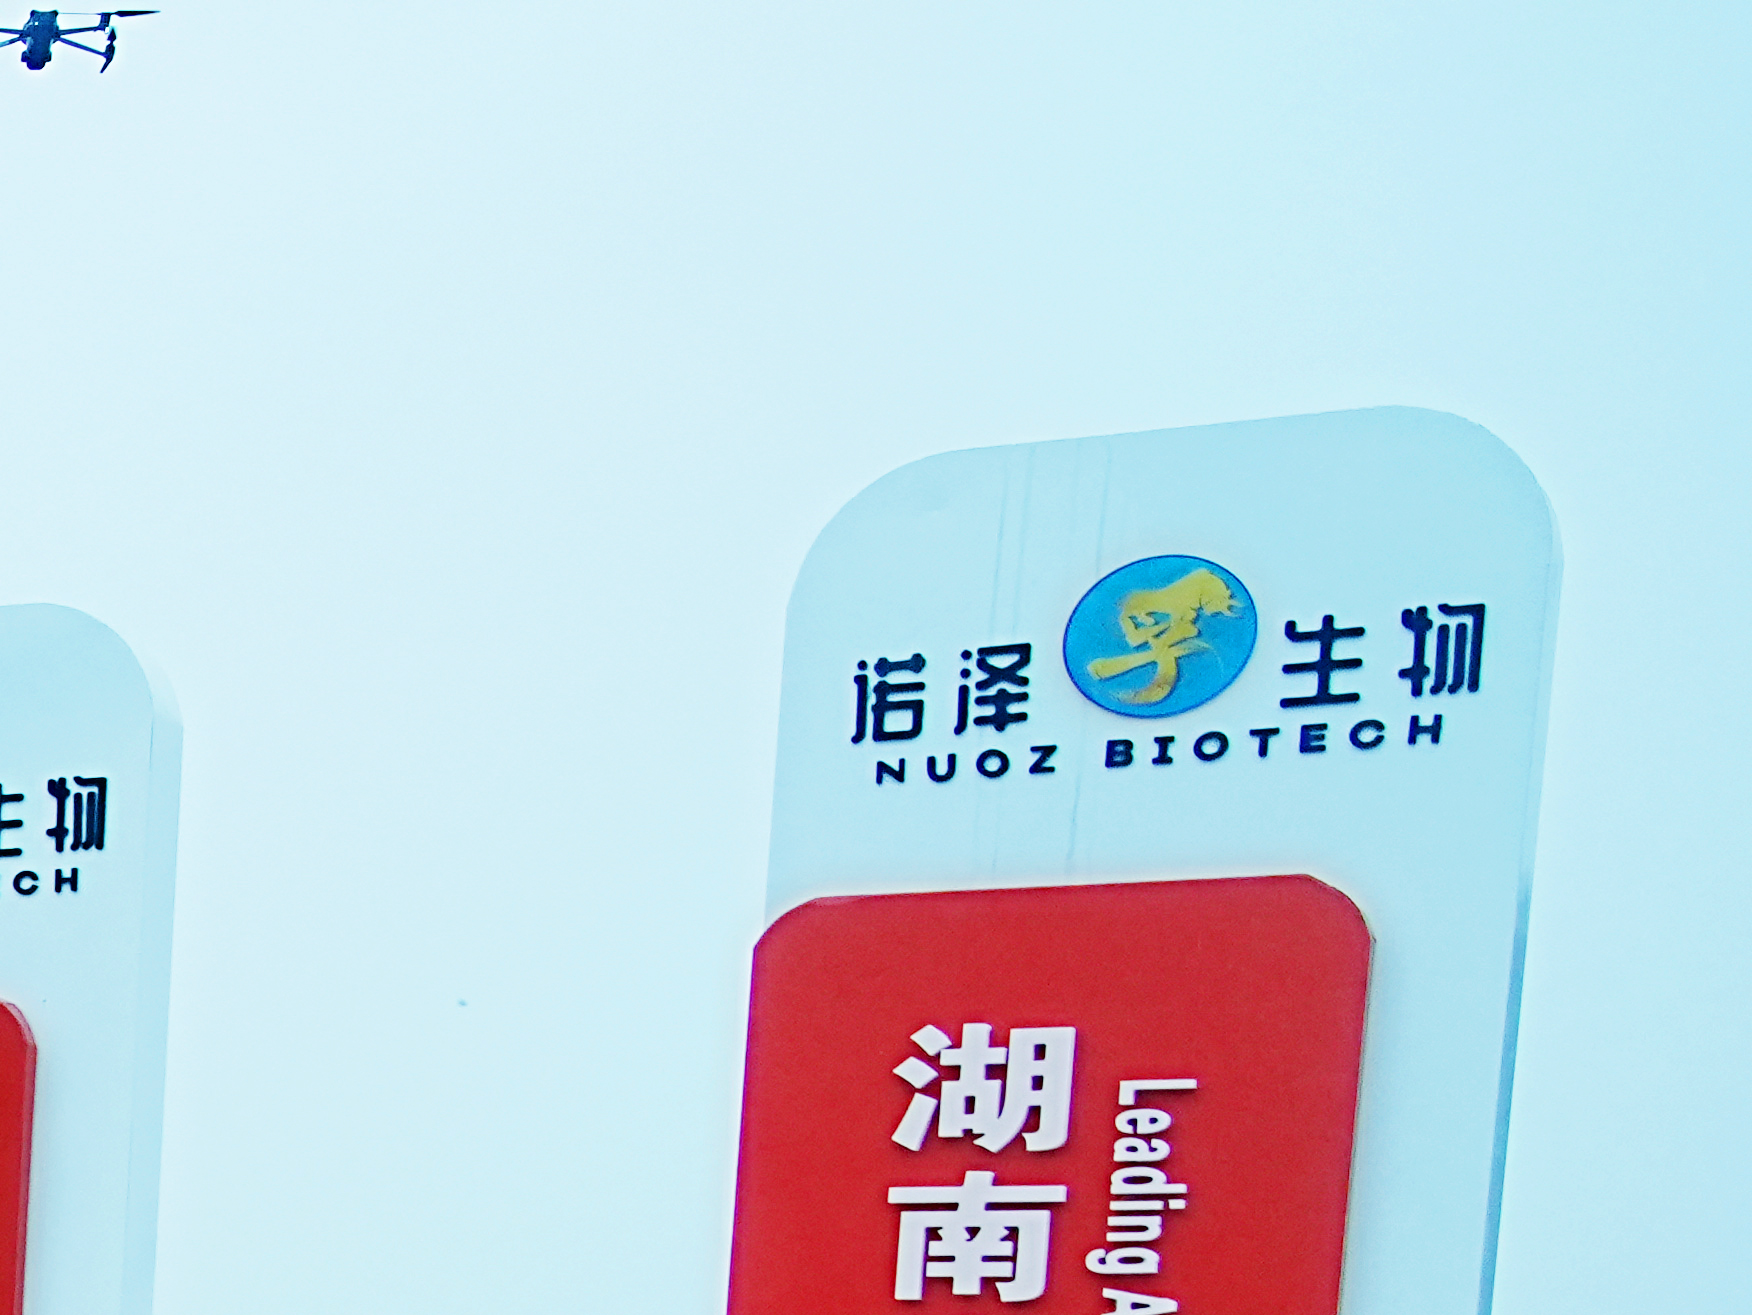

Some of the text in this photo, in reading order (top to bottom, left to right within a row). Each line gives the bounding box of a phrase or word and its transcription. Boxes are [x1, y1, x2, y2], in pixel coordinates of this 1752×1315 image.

[1281, 604, 1485, 707] 生物
[877, 715, 1442, 783] NUOZ BIOTECH
[1085, 1079, 1197, 1274] Leading
